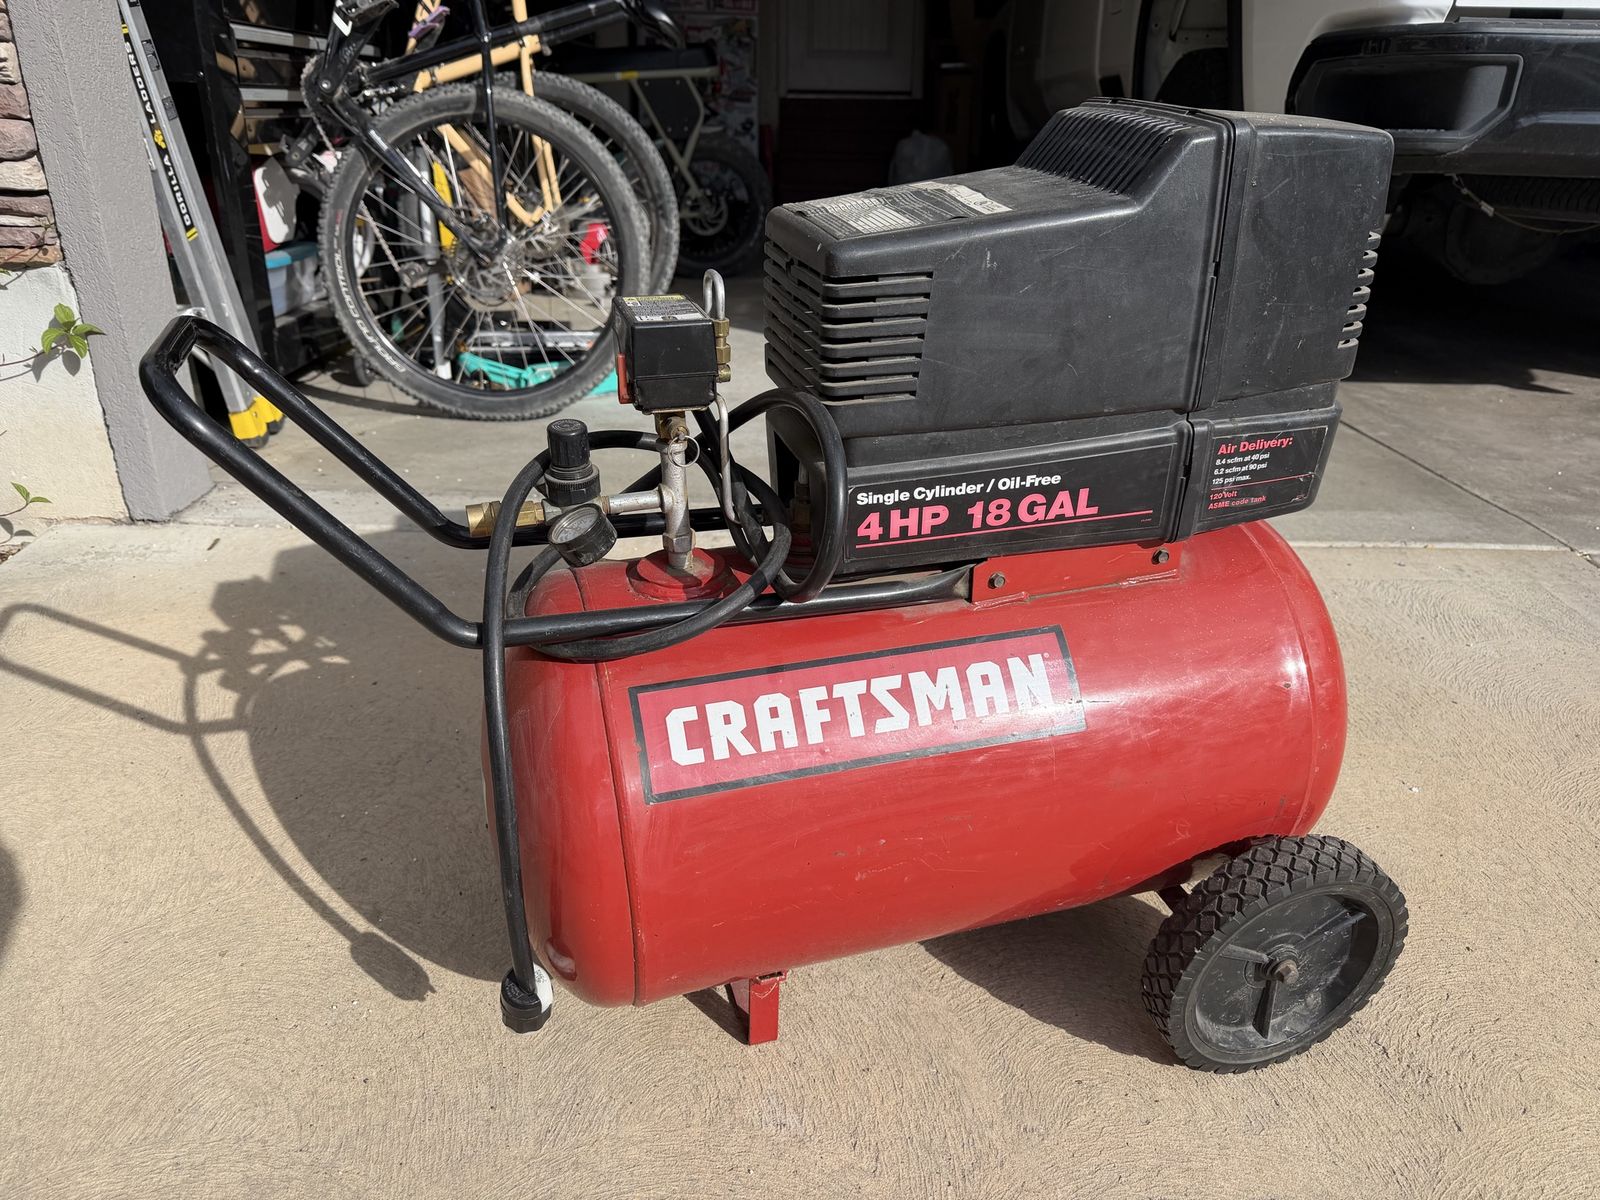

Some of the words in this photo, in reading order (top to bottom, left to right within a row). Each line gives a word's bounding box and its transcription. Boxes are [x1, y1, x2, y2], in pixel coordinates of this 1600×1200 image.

[124, 41, 157, 124] LADDERS
[163, 153, 192, 226] GORILLA
[1218, 442, 1237, 455] Air
[1239, 437, 1293, 453] Delivery:
[1227, 456, 1243, 465] scfm
[1259, 452, 1270, 462] psi
[1225, 466, 1241, 474] scfm
[1248, 463, 1257, 471] 90
[1257, 462, 1268, 471] psi
[1224, 476, 1235, 485] psi
[1235, 474, 1252, 482] max.
[856, 489, 910, 506] Single
[913, 481, 984, 501] Cylinder
[986, 477, 995, 493] /
[997, 473, 1062, 491] Oil-Free
[1209, 493, 1223, 501] 120
[1223, 490, 1238, 499] Volt
[1208, 501, 1230, 510] ASME
[1231, 498, 1249, 507] code
[1250, 495, 1267, 504] tank
[857, 511, 884, 541] 4
[889, 504, 950, 539] HP
[967, 497, 1012, 529] 18
[1017, 487, 1099, 524] GAL
[665, 652, 1054, 766] CRAFTSMAN
